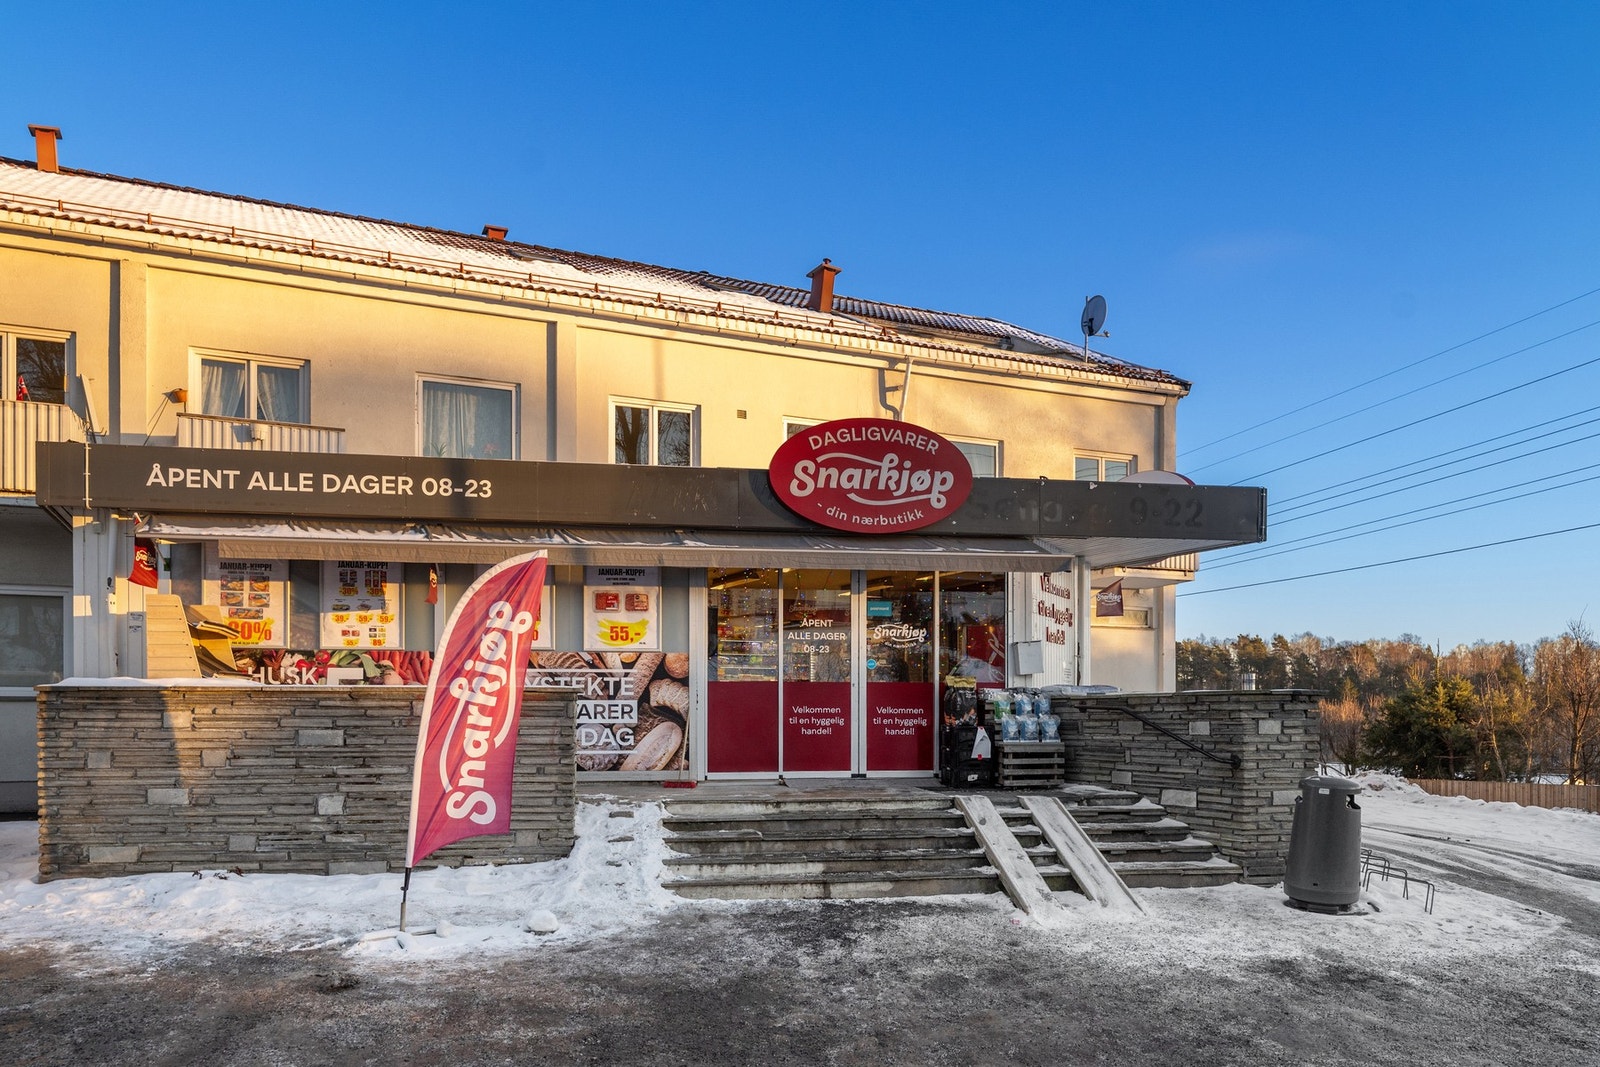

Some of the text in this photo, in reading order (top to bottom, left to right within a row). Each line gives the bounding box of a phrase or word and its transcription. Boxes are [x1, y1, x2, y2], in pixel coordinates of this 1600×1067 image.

[808, 426, 940, 454] DAGLIGVARER
[146, 463, 492, 498] ÅPENT ALLE DAGER 08-23
[790, 452, 954, 510] Snarkjøp
[826, 506, 847, 520] din
[852, 508, 924, 526] nærbutikk
[801, 618, 834, 627] ÅPENT
[610, 626, 641, 642] 55,-
[873, 624, 926, 642] Snarkjøp
[248, 666, 318, 685] HUSK
[440, 600, 533, 826] Snarkjøp
[812, 716, 844, 726] hyggelig
[895, 717, 927, 727] hyggelig
[582, 728, 634, 746] DAG
[802, 727, 832, 735] handel!
[885, 727, 915, 735] handel!
